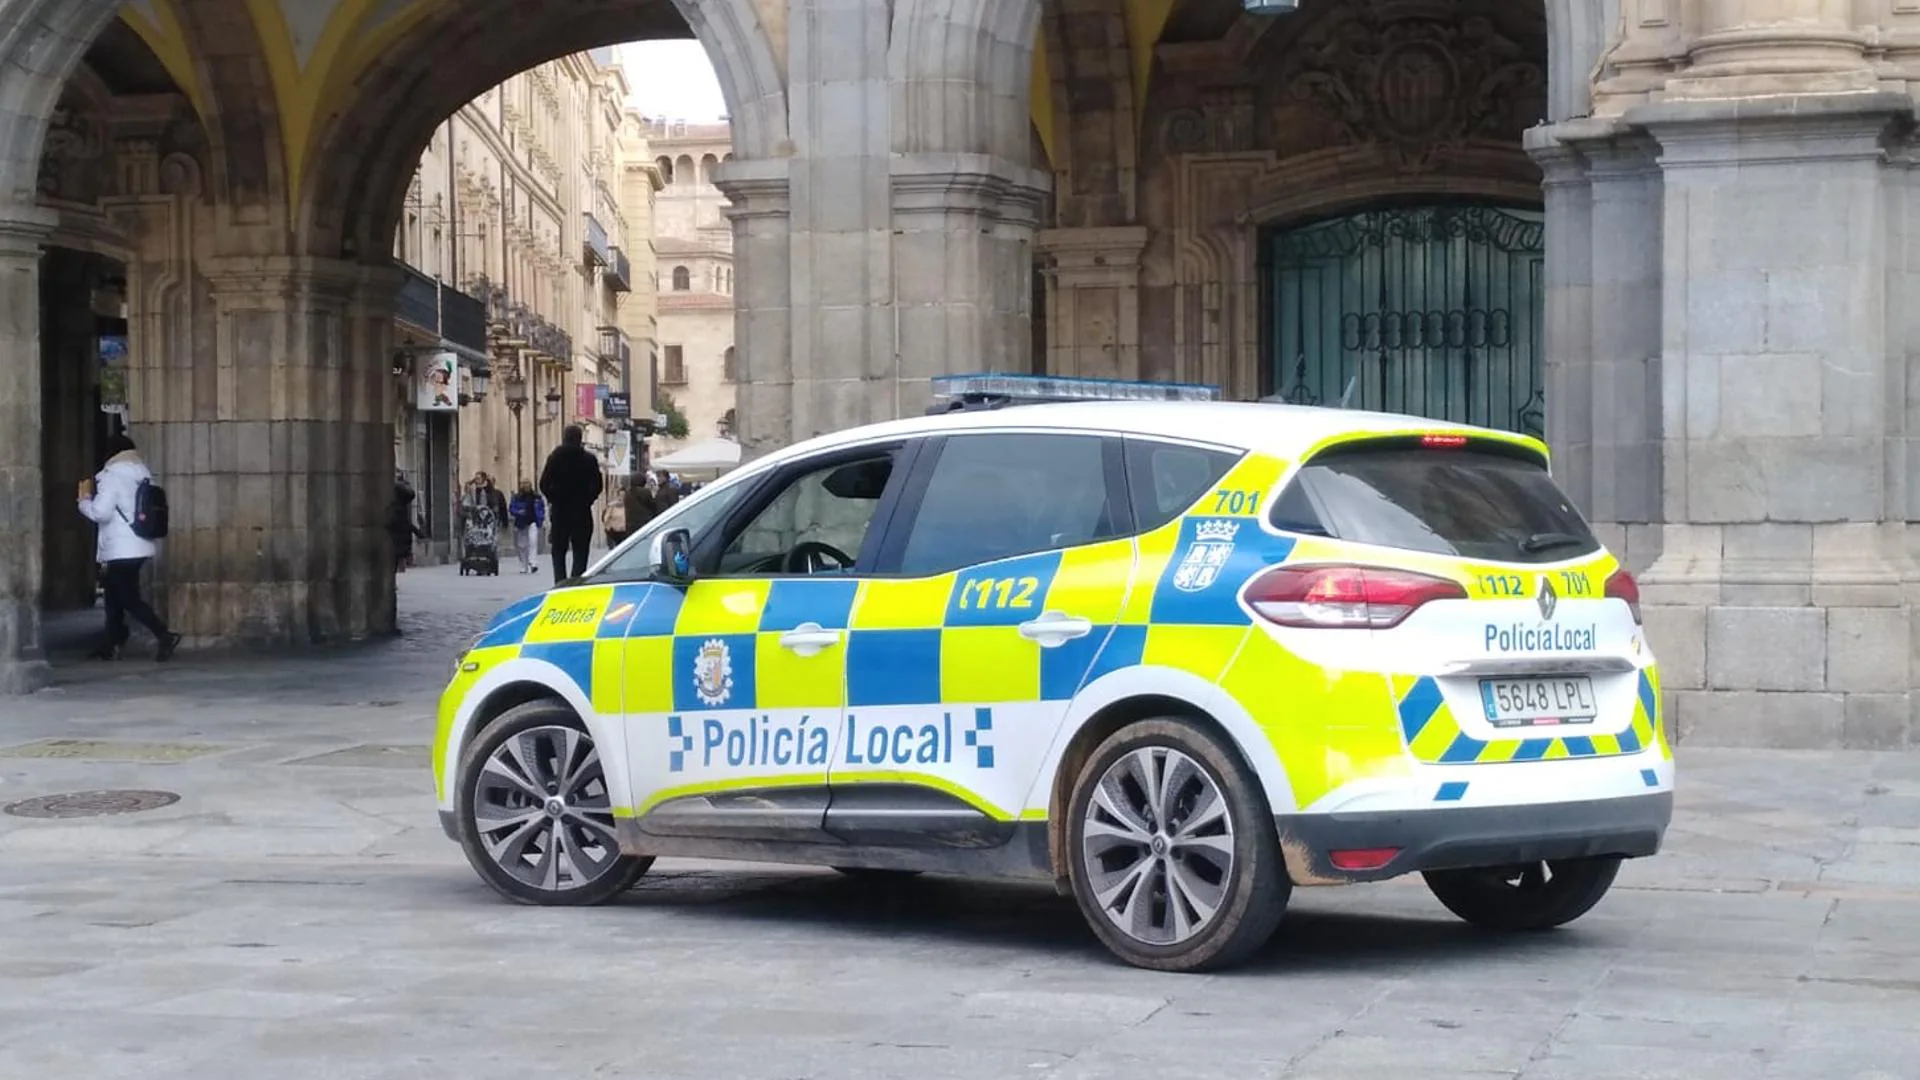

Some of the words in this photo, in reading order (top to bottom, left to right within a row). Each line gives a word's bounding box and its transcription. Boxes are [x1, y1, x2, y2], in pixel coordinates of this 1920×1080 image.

[1215, 489, 1260, 514] 701
[975, 576, 1039, 609] 112
[1485, 575, 1524, 596] 112
[1560, 572, 1592, 595] 701
[1485, 621, 1552, 652] Policía
[1555, 623, 1597, 650] Local
[1496, 682, 1549, 712] 5648
[1552, 681, 1590, 710] LPL
[703, 714, 829, 767] Policía
[845, 712, 952, 765] Local
